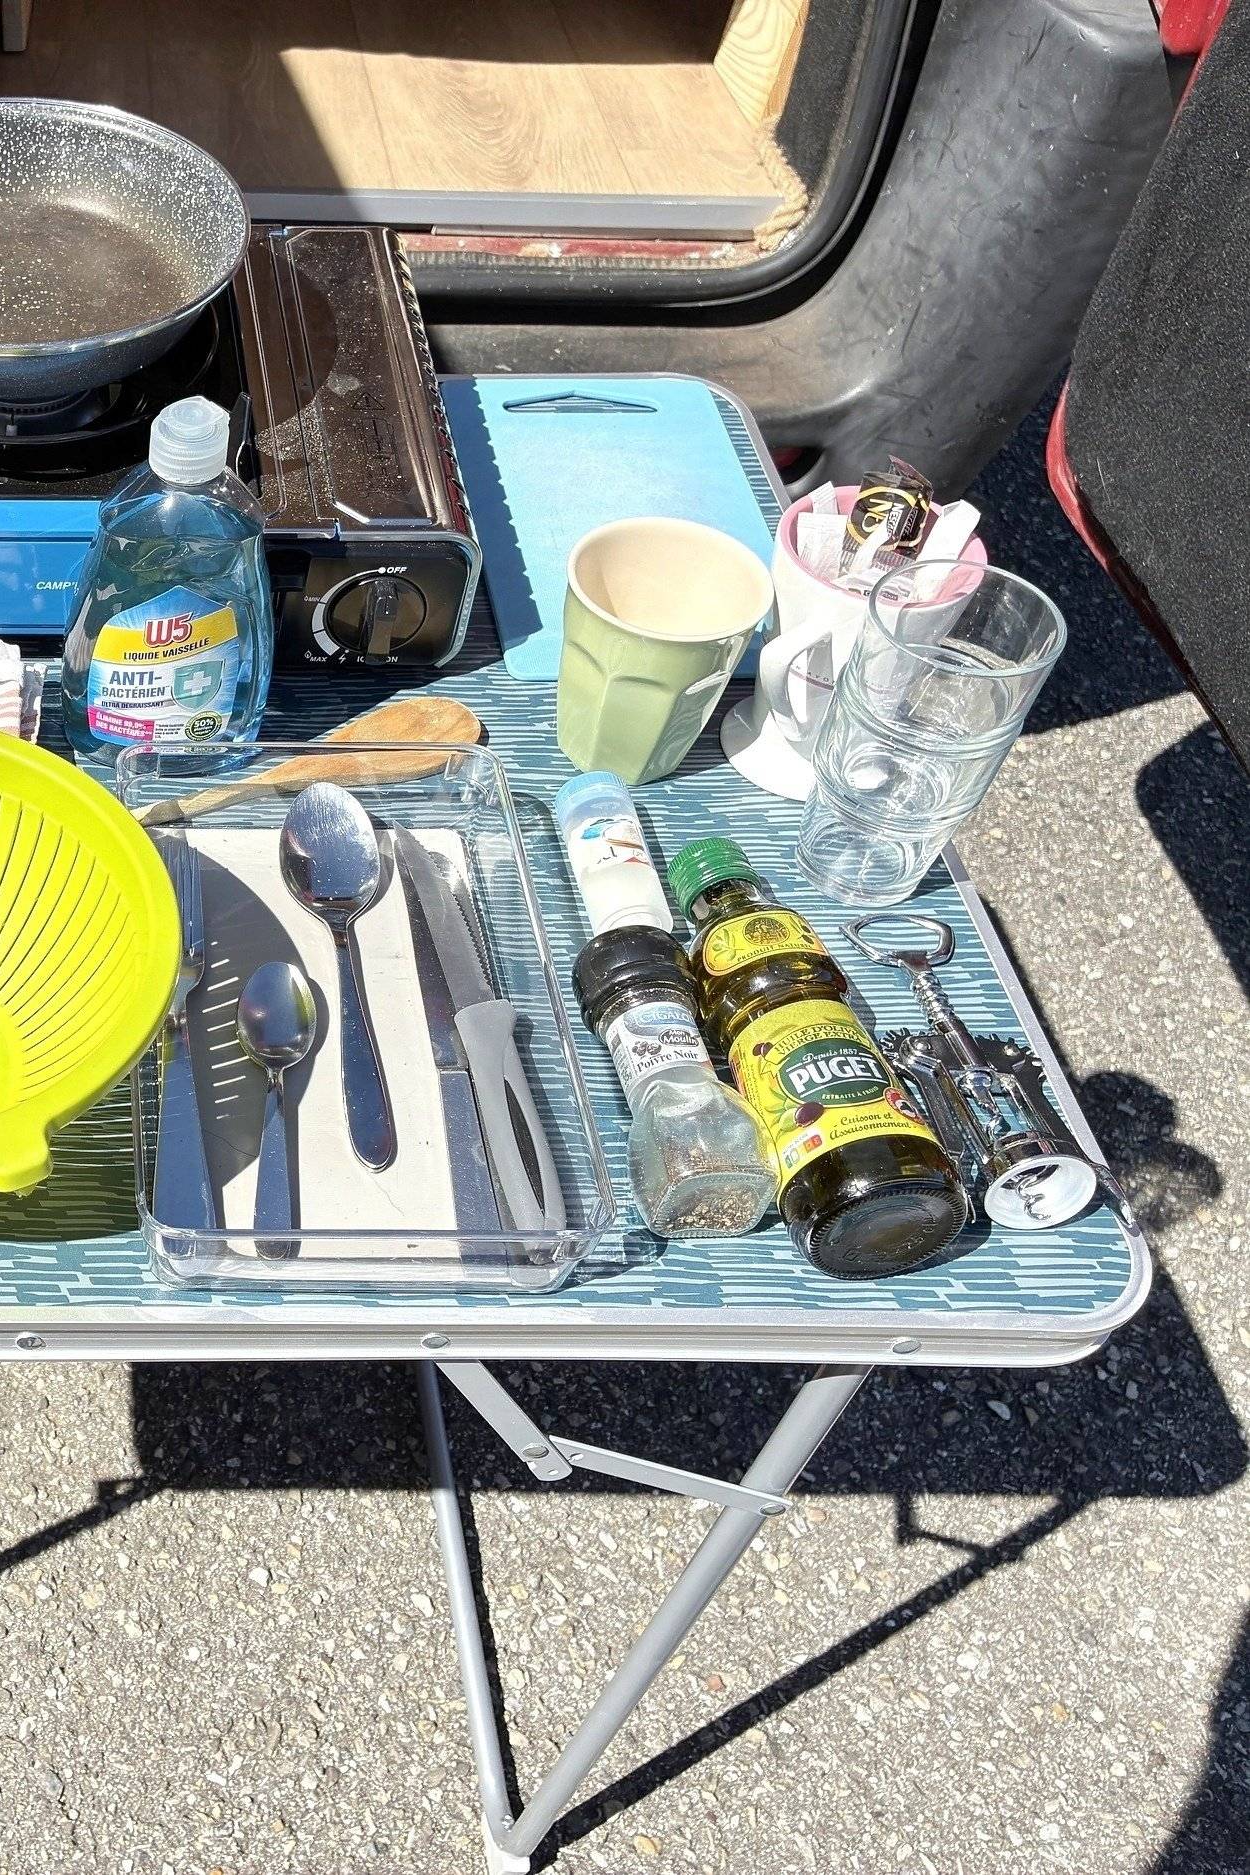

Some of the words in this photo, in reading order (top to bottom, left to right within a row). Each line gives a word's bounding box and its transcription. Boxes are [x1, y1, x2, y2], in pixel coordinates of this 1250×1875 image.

[386, 566, 408, 574] OFF
[144, 612, 194, 648] W5
[123, 649, 160, 662] LIQUIDE
[162, 637, 210, 659] VAISSELLE
[109, 670, 163, 686] ANTI-
[101, 700, 119, 708] ULTRA
[95, 720, 109, 730] DES
[194, 718, 214, 728] 50%
[737, 945, 774, 962] PRODUIT
[663, 1034, 699, 1045] Moulin
[774, 1028, 811, 1052] HUILE
[778, 1032, 823, 1055] VIERGE
[825, 1031, 863, 1043] EXTRA
[636, 1052, 672, 1072] Poivre
[673, 1049, 699, 1060] Noir
[802, 1050, 838, 1062] Depuis
[789, 1056, 883, 1094] PUGET
[840, 1112, 882, 1126] Cuisson
[883, 1111, 894, 1119] et
[829, 1121, 912, 1141] Assaisonnement
